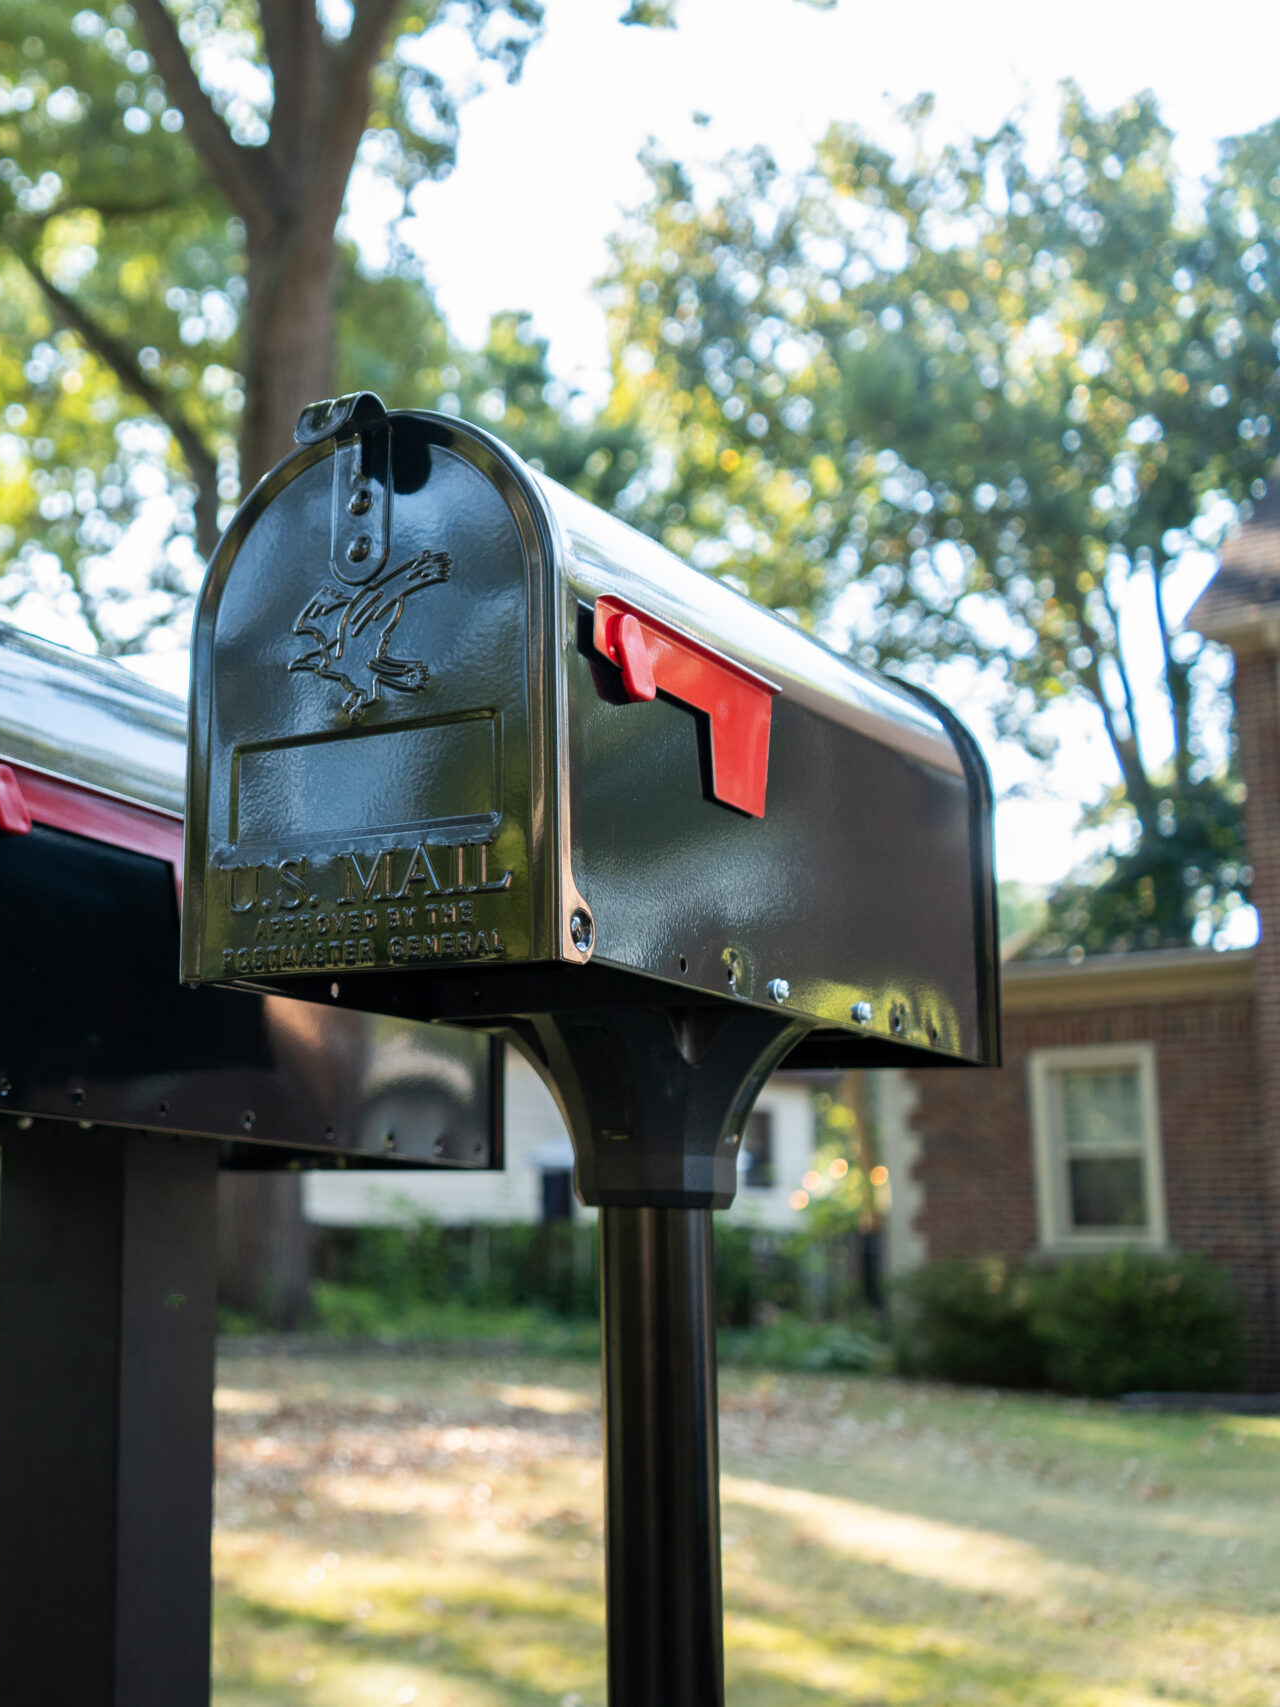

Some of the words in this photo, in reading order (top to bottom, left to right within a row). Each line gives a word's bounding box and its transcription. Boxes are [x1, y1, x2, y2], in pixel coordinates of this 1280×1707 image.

[220, 854, 320, 912] U.S.
[336, 838, 514, 905] MAIL
[254, 909, 378, 940] APPROVED
[387, 906, 417, 930] BY
[425, 901, 474, 927] THE
[222, 938, 377, 971] POSTMASTER
[389, 929, 505, 962] GENERAL
